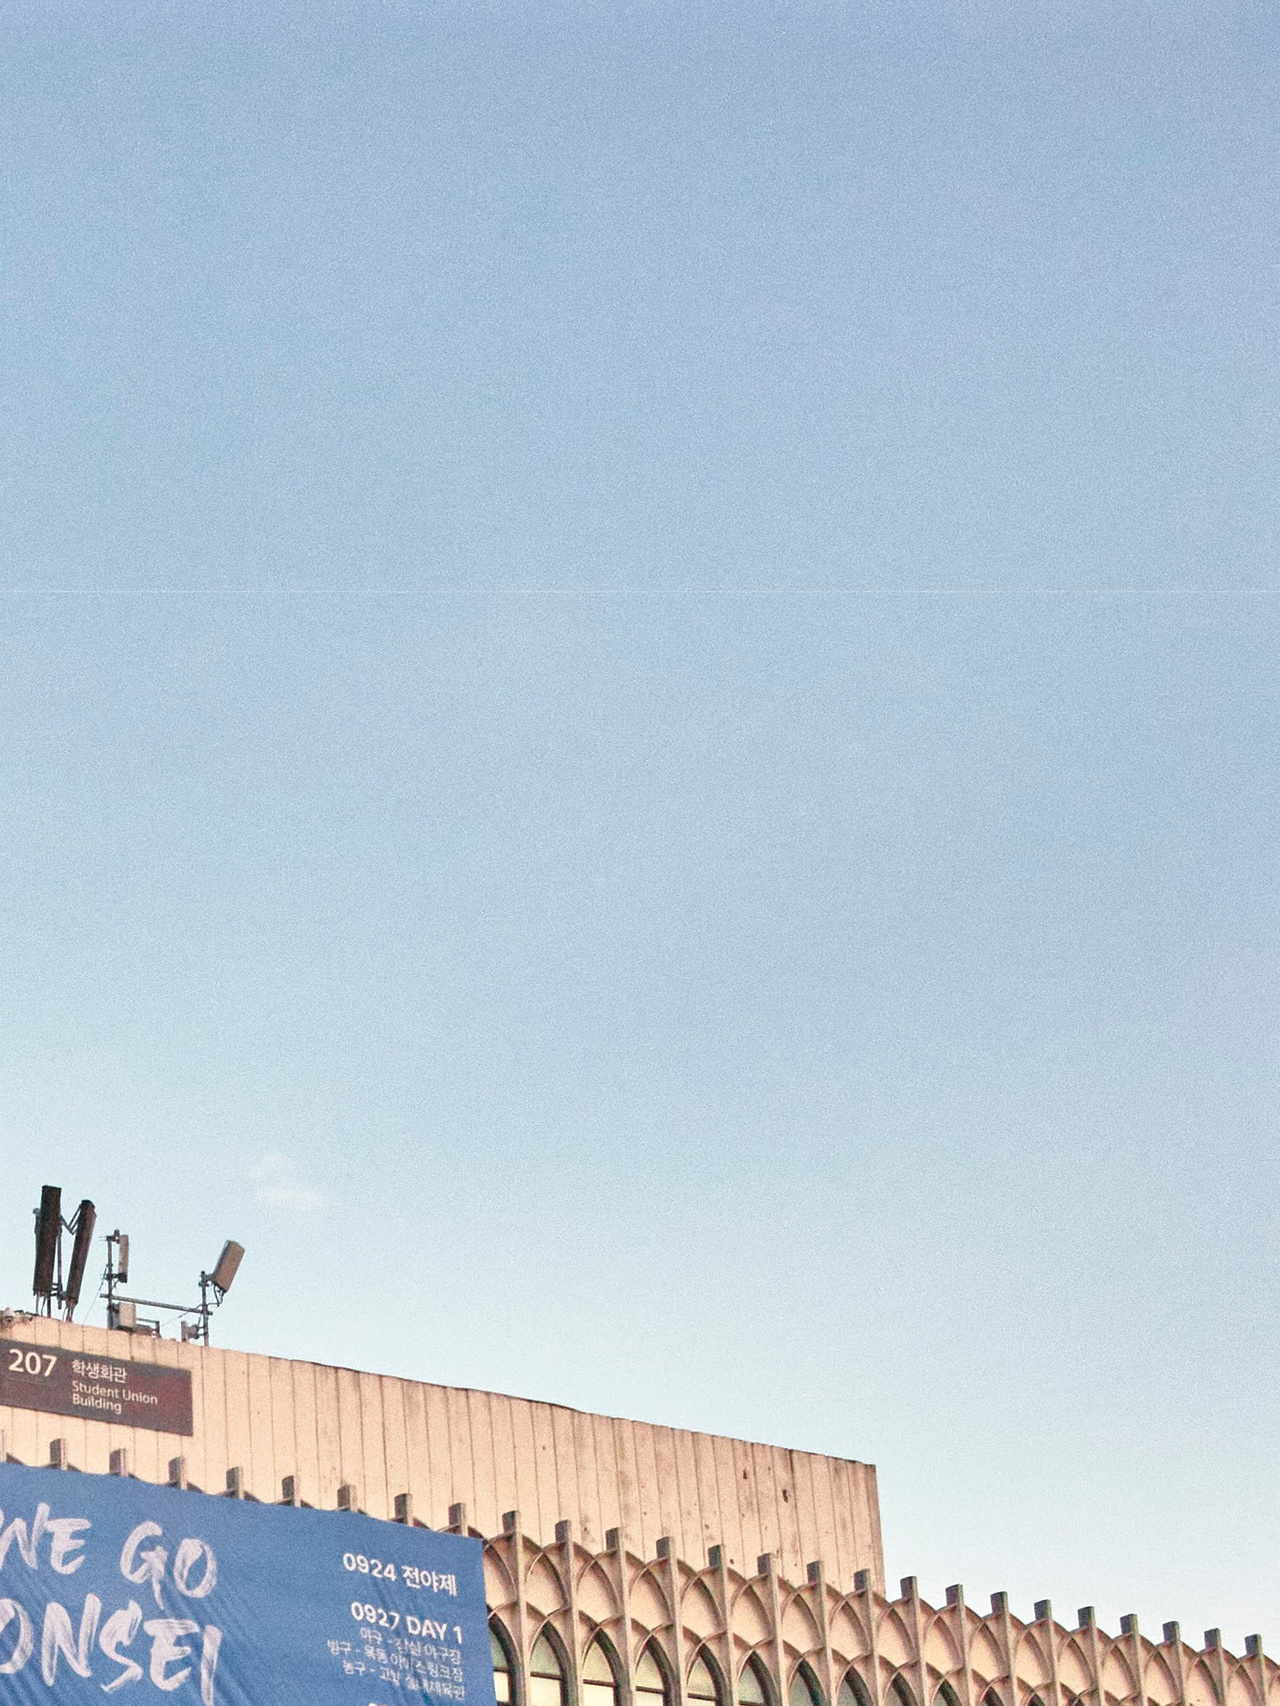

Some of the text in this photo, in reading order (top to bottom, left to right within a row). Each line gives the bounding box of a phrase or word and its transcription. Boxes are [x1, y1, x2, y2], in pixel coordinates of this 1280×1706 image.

[8, 1348, 57, 1377] 207
[72, 1359, 127, 1384] 학생회관
[72, 1380, 158, 1405] Student Union
[72, 1393, 122, 1414] Building
[120, 1520, 217, 1610] GO
[342, 1552, 458, 1597] 0924 전야제
[351, 1601, 463, 1645] 0927 DAY 1
[360, 1627, 383, 1644] 야구
[424, 1644, 461, 1665] 야구장
